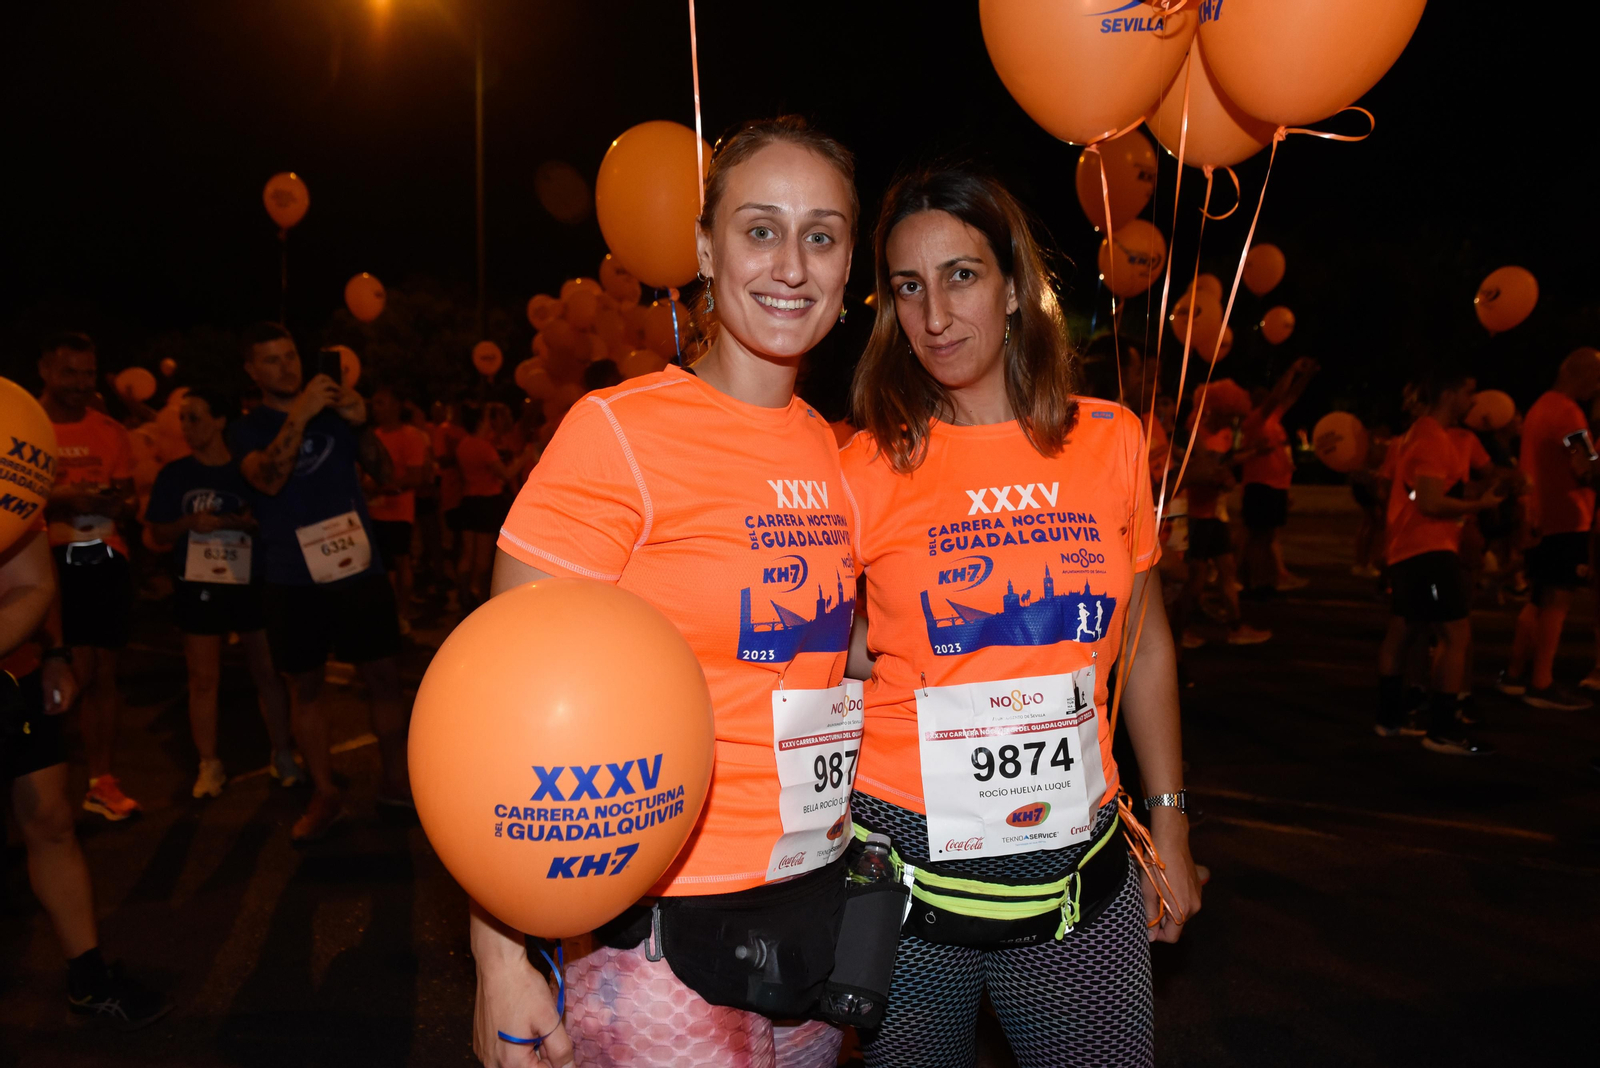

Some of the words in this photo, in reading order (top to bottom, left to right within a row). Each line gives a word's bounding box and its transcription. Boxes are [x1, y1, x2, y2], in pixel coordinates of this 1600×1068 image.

[1100, 17, 1164, 34] SEVILLA
[766, 479, 829, 510] XXXV
[965, 481, 1060, 516] XXXV
[745, 514, 806, 529] CARRERA
[928, 517, 1006, 538] CARRERA
[1011, 512, 1097, 527] NOCTURNA
[321, 536, 355, 557] 6324
[749, 530, 760, 550] DEL
[928, 538, 937, 557] DEL
[939, 526, 1102, 553] GUADALQUIVIR
[204, 548, 238, 561] 6325
[742, 649, 775, 661] 2023
[934, 642, 962, 654] 2023
[949, 730, 979, 739] CARRERA
[1020, 724, 1030, 732] DEL
[781, 741, 796, 749] XXXV
[796, 738, 818, 747] CARRERA
[971, 737, 1075, 782] 9874
[529, 753, 663, 802] XXXV
[813, 748, 859, 793] 987
[979, 787, 1008, 799] ROCÍO
[1010, 783, 1043, 796] HUELVA
[1044, 780, 1072, 792] LUQUE
[494, 804, 590, 822] CARRERA
[594, 784, 685, 819] NOCTURNA
[803, 803, 819, 814] BELLA
[819, 797, 838, 810] ROCÍO
[495, 821, 503, 838] DEL
[506, 799, 685, 842] GUADALQUIVIR
